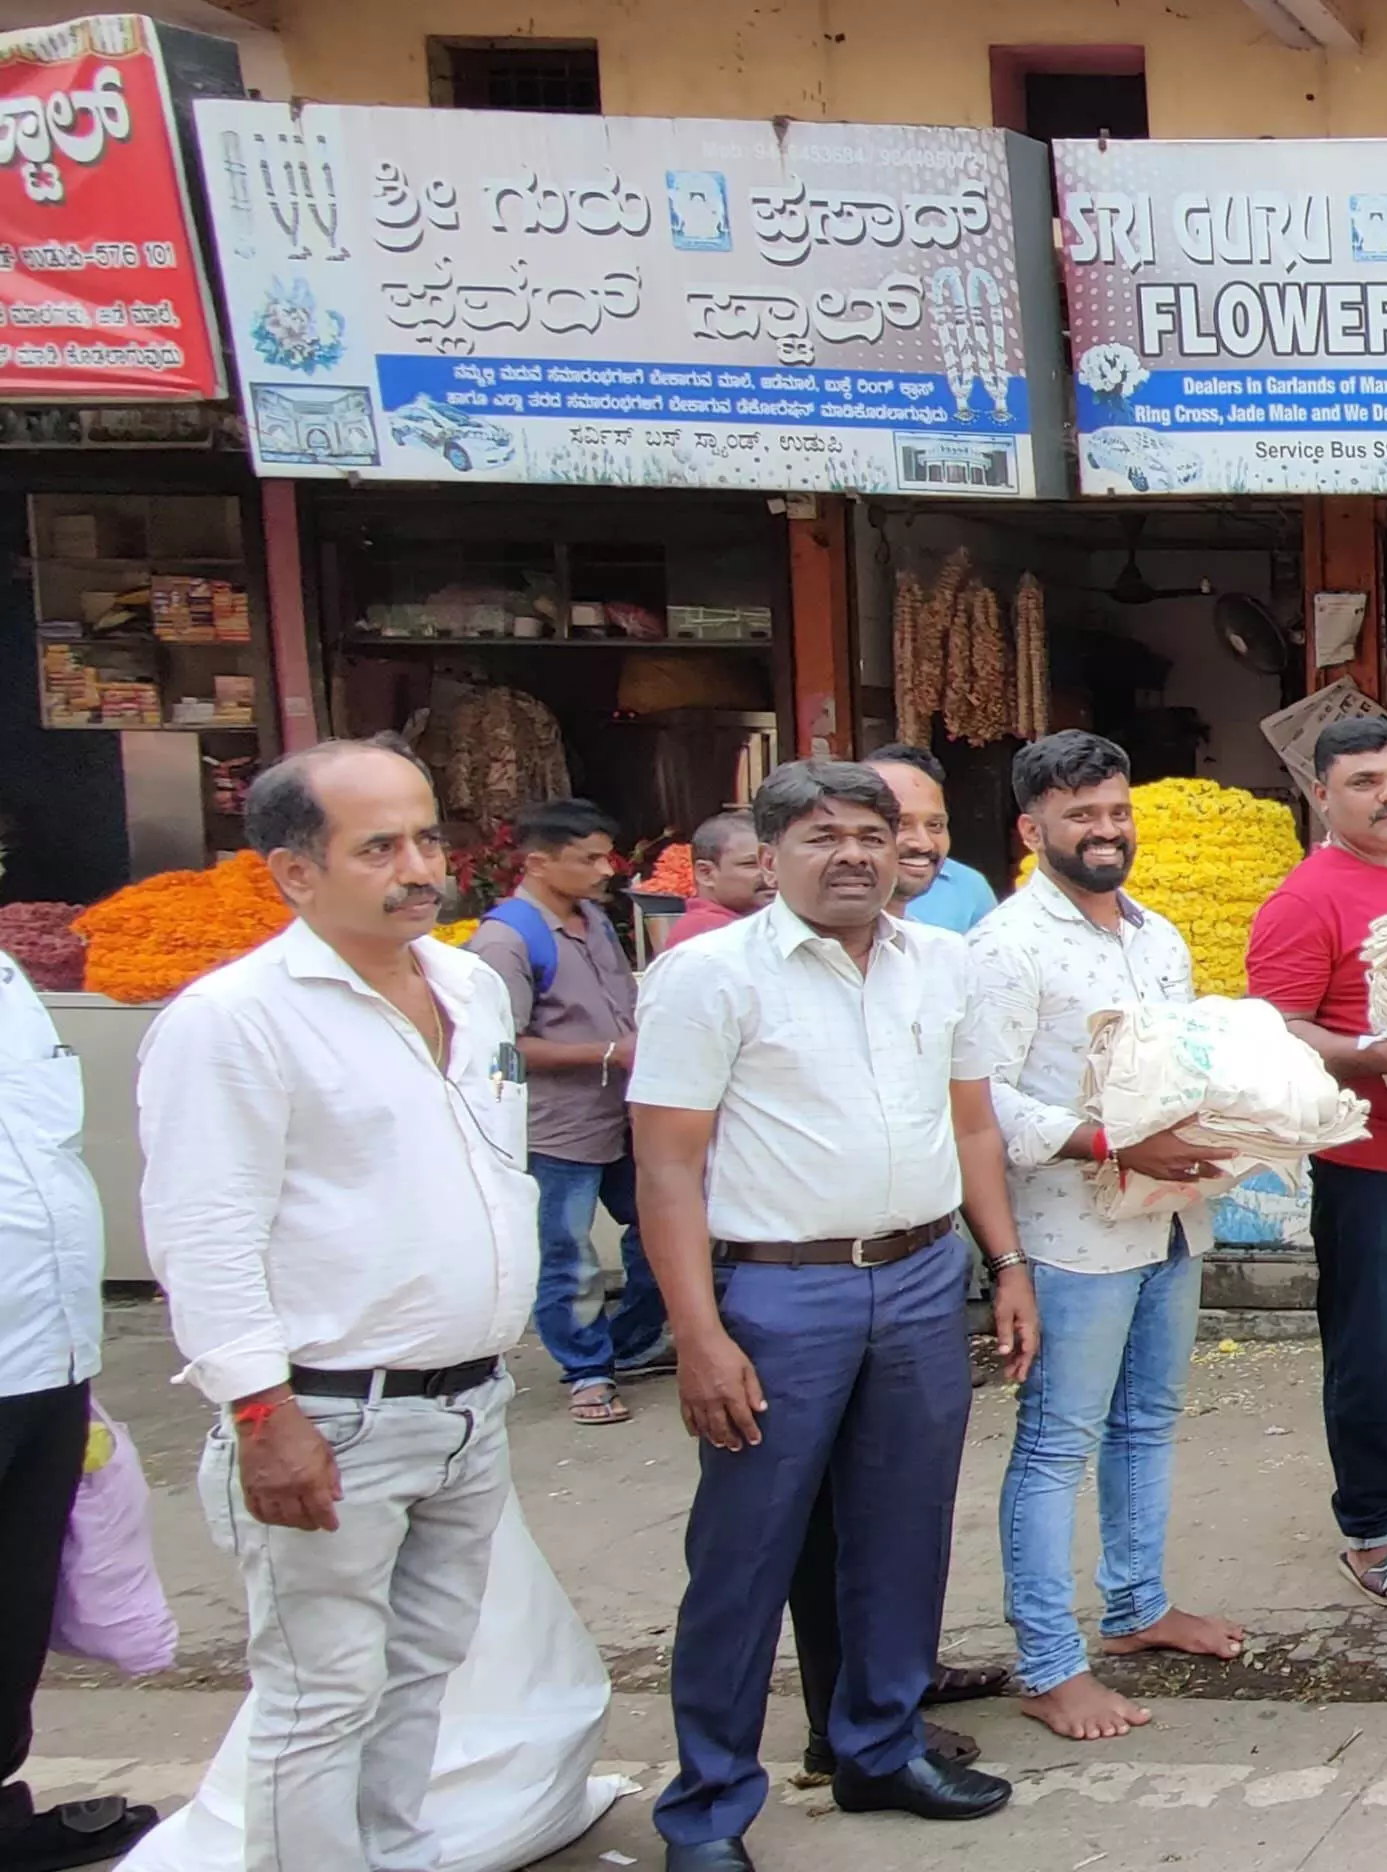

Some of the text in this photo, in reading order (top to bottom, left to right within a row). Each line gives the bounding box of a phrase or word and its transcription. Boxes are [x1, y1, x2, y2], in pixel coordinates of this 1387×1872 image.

[372, 158, 994, 266] ಶ್ರೀ ಗುರು ಪ್ರಸಾದ್
[1066, 192, 1155, 273] SRI
[1171, 193, 1333, 273] GURU
[684, 274, 926, 367] ಸ್ಟಾಲ್
[1183, 376, 1243, 396] Dealers
[1246, 376, 1262, 394] in
[1266, 376, 1336, 395] Garlands
[1340, 376, 1356, 394] of
[1134, 404, 1171, 427] Ring
[1174, 404, 1225, 425] Cross,
[1227, 404, 1265, 422] Jade
[1269, 404, 1307, 422] Male
[1311, 404, 1339, 422] and
[1344, 404, 1368, 421] We
[647, 427, 682, 447] ಬಸ್
[779, 434, 843, 453] ಉಡುಪಿ
[1255, 440, 1325, 459] Service
[1331, 440, 1367, 459] Bus
